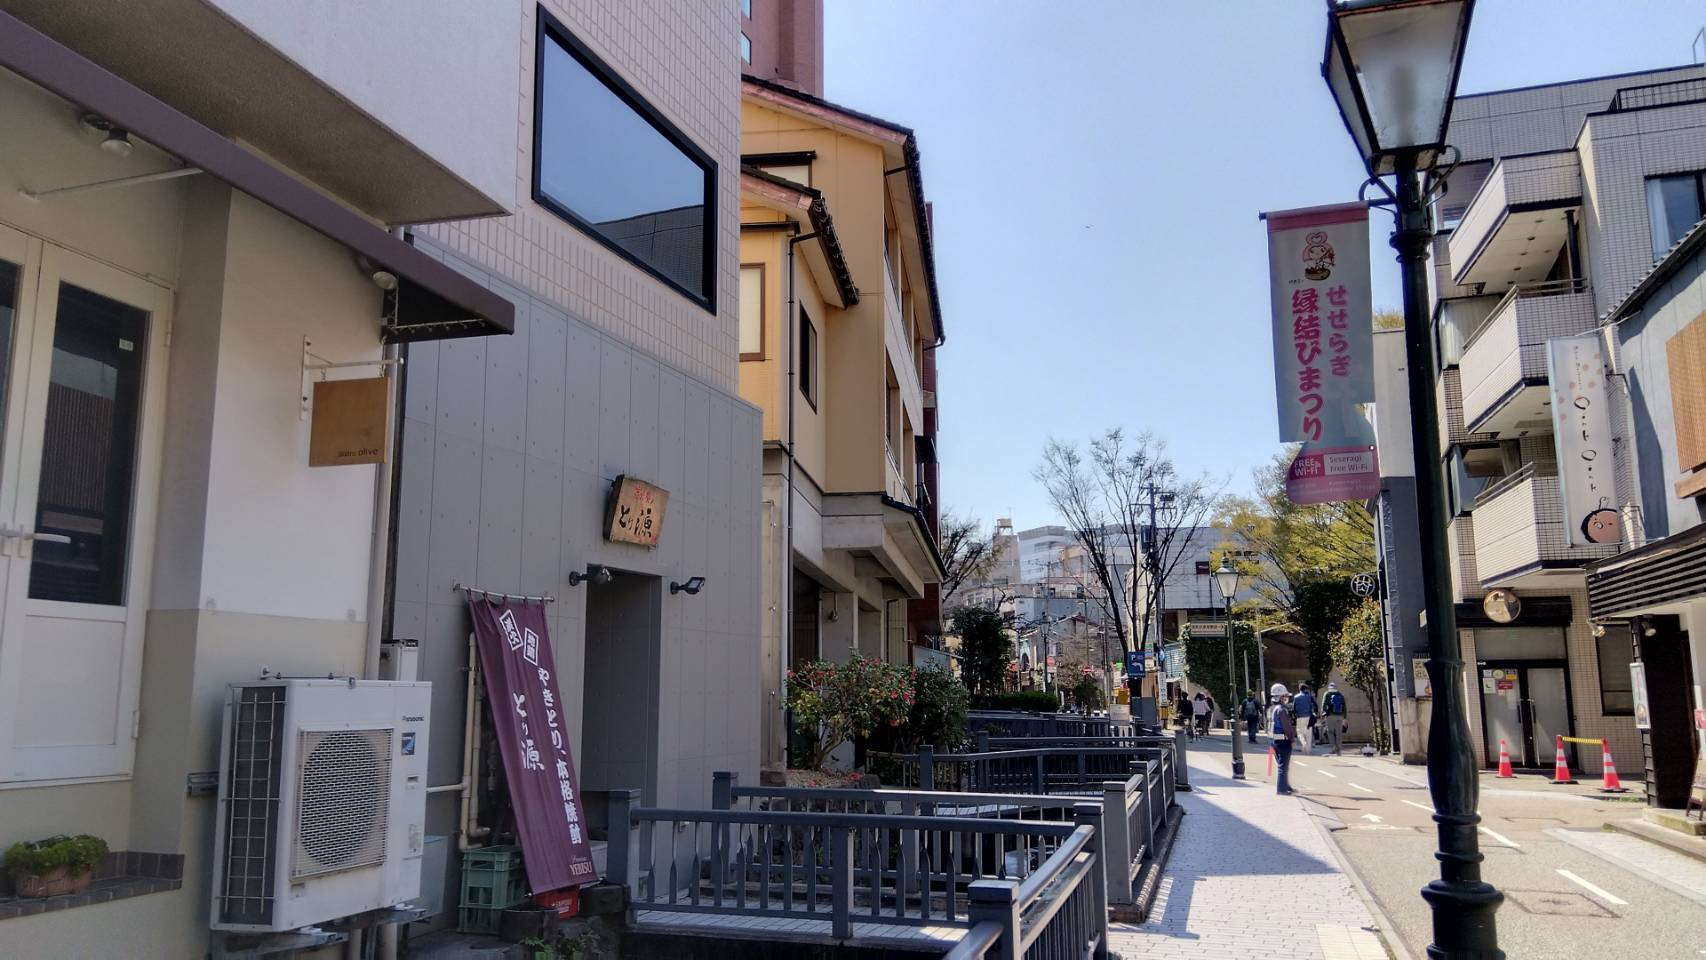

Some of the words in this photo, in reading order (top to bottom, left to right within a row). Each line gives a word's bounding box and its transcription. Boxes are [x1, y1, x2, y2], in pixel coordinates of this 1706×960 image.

[1326, 285, 1351, 377] せせらぎ
[1291, 287, 1325, 442] 縁結びまつり
[358, 448, 378, 457] olive
[1329, 455, 1361, 464] Seseragi
[1294, 458, 1315, 468] FREE
[512, 691, 545, 772] とり源
[569, 861, 593, 876] YEBISU
